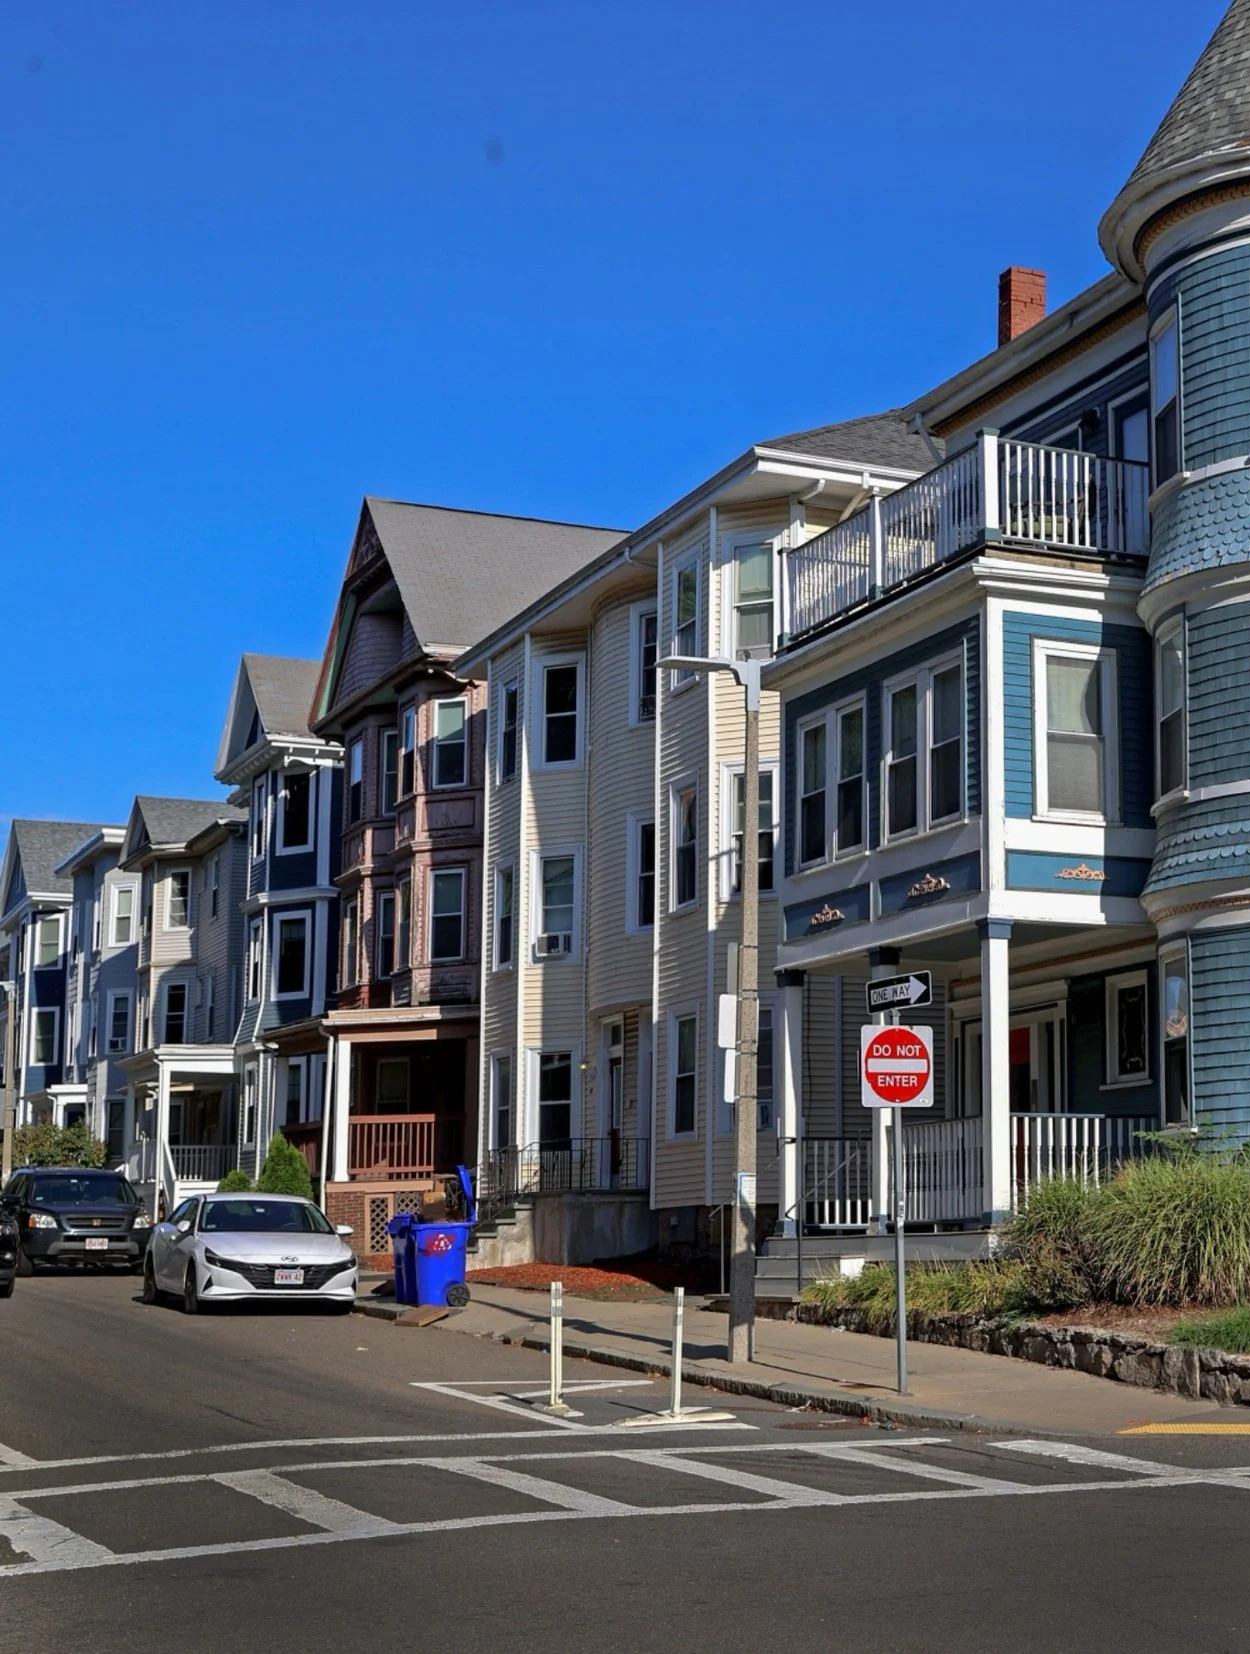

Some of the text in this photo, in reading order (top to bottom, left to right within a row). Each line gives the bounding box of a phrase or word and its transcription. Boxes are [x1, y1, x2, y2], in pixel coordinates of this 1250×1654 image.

[872, 985, 911, 1003] ONE WAY
[873, 1045, 922, 1056] DO NOT
[877, 1075, 918, 1087] ENTER
